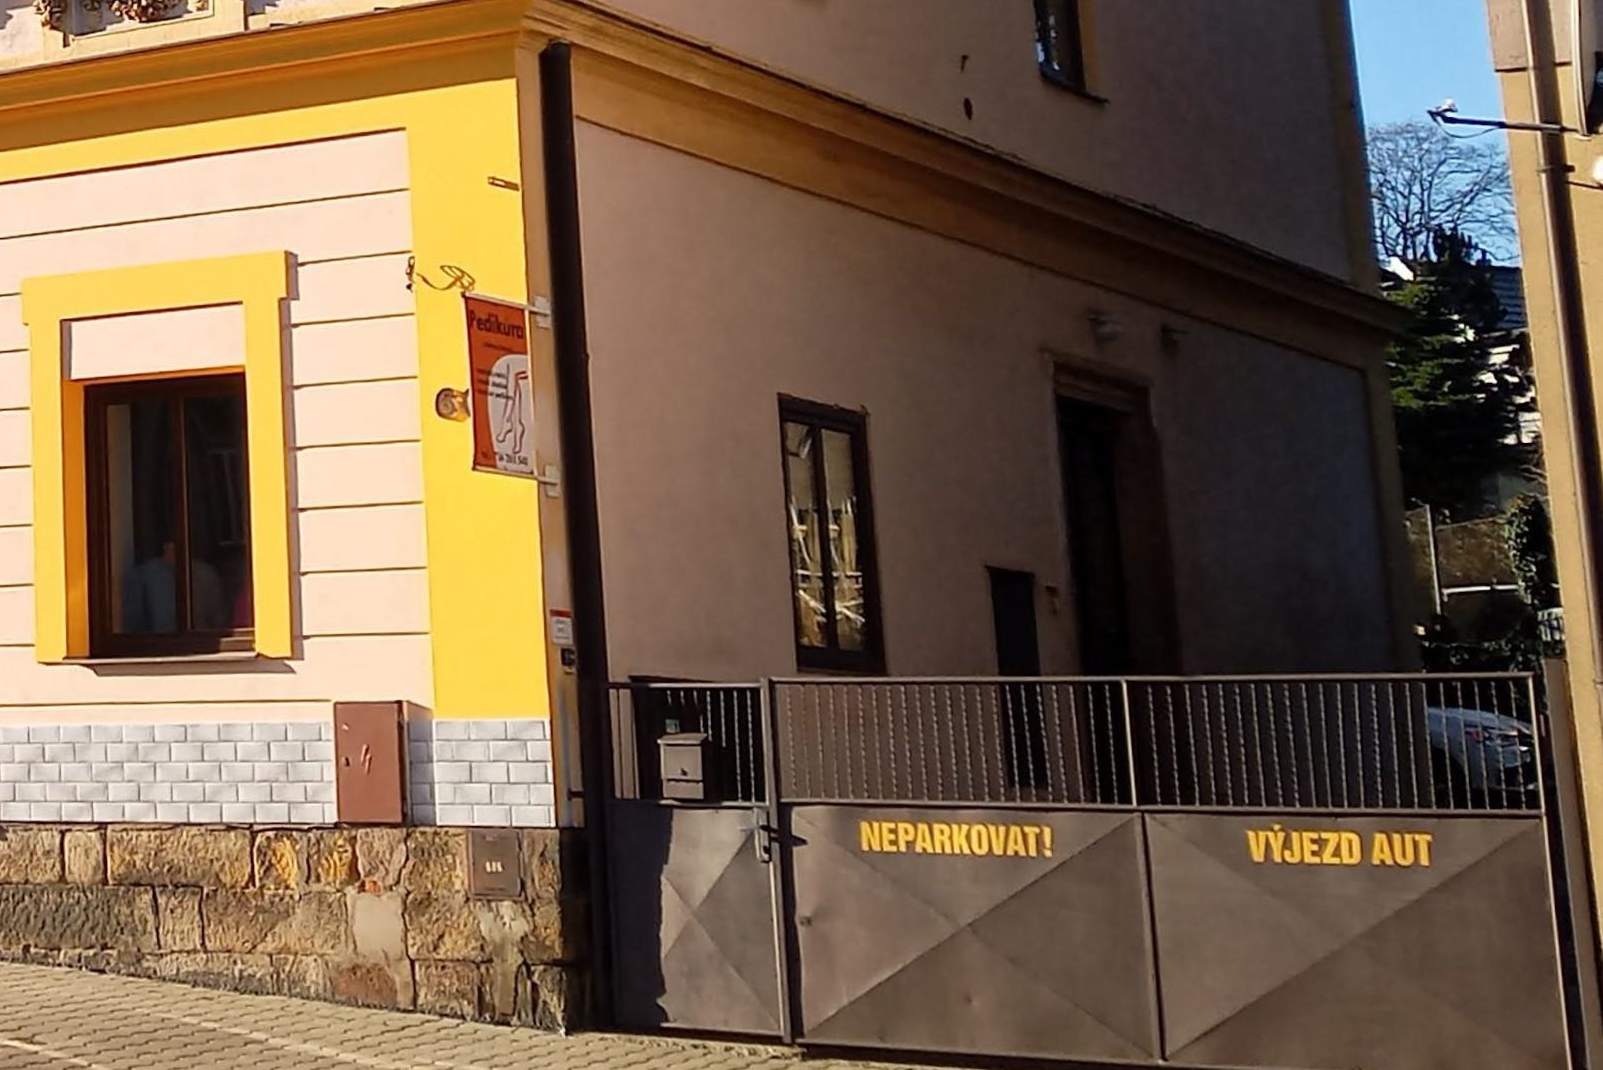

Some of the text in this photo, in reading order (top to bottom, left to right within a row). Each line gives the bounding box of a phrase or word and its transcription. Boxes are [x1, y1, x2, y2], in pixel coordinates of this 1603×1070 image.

[859, 820, 1053, 858] NEPARKOVAT!
[1247, 823, 1433, 867] VÝJEZD AUT
